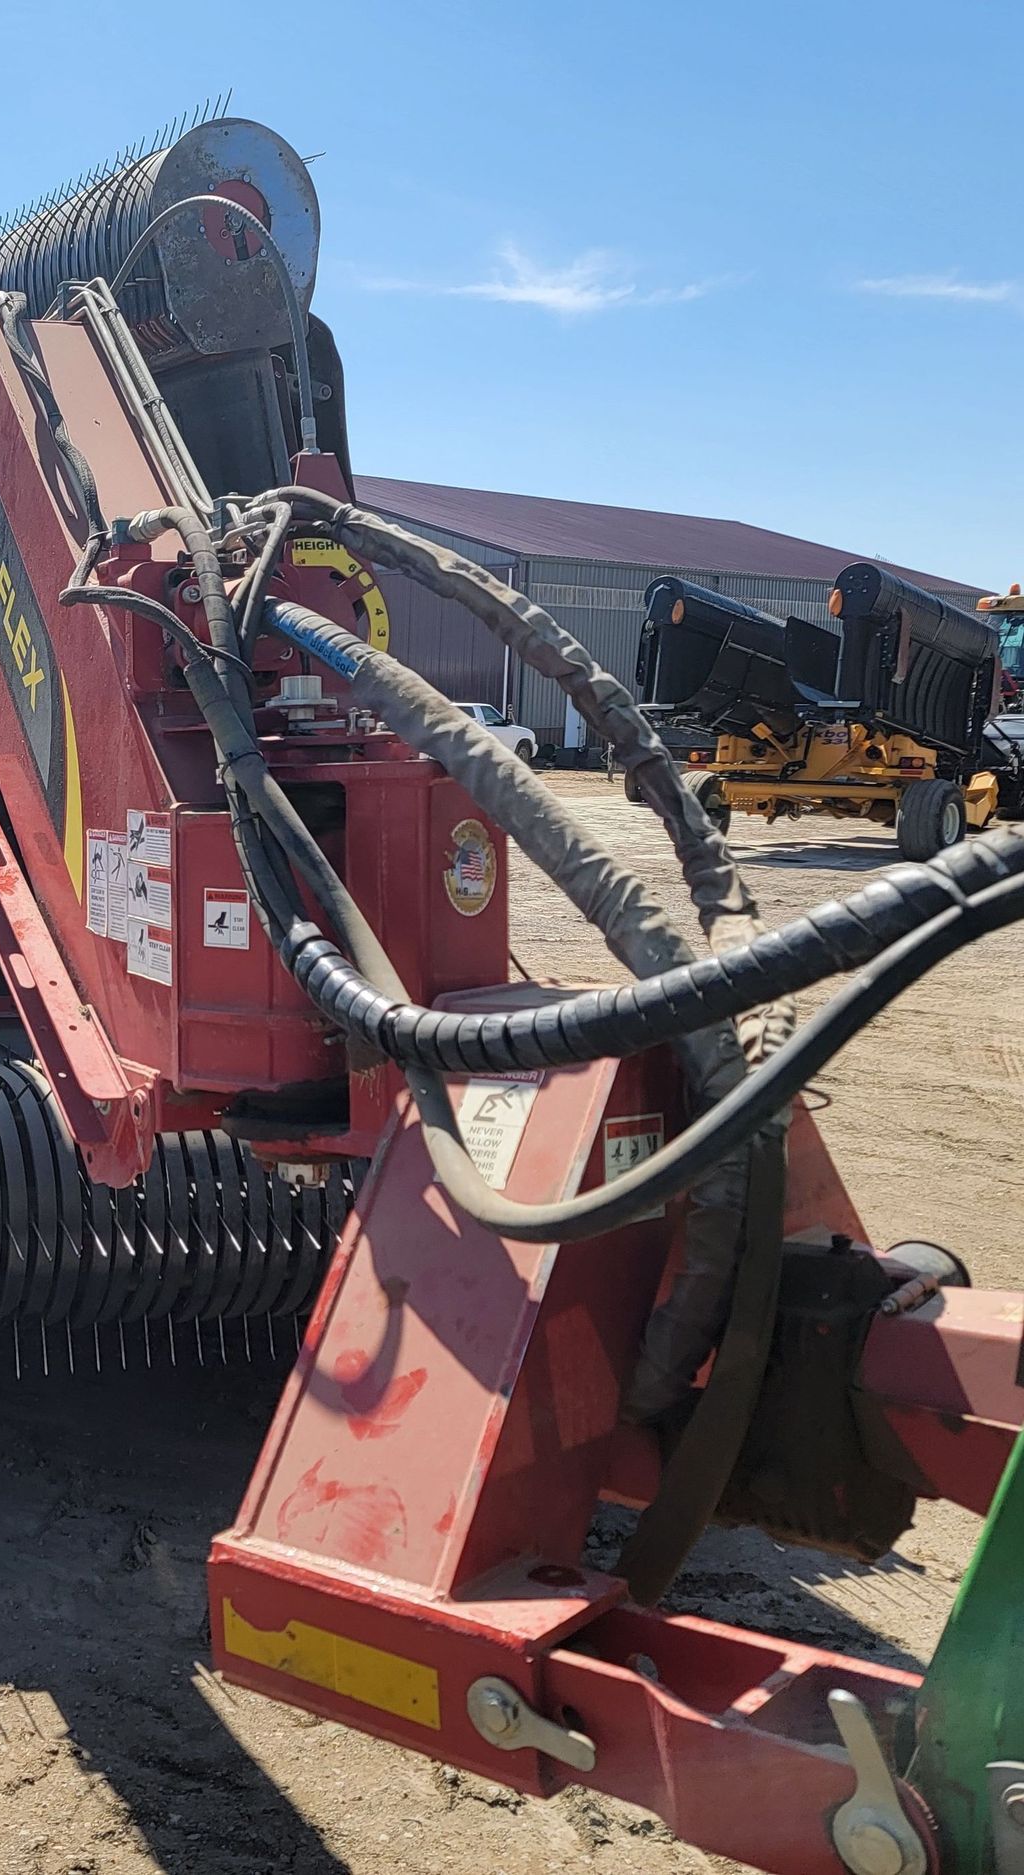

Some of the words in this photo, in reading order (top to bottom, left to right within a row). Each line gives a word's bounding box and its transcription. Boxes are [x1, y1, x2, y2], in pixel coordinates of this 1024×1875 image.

[375, 607, 384, 616] 4
[469, 1126, 504, 1137] NEVER
[465, 1137, 502, 1149] ALLOW
